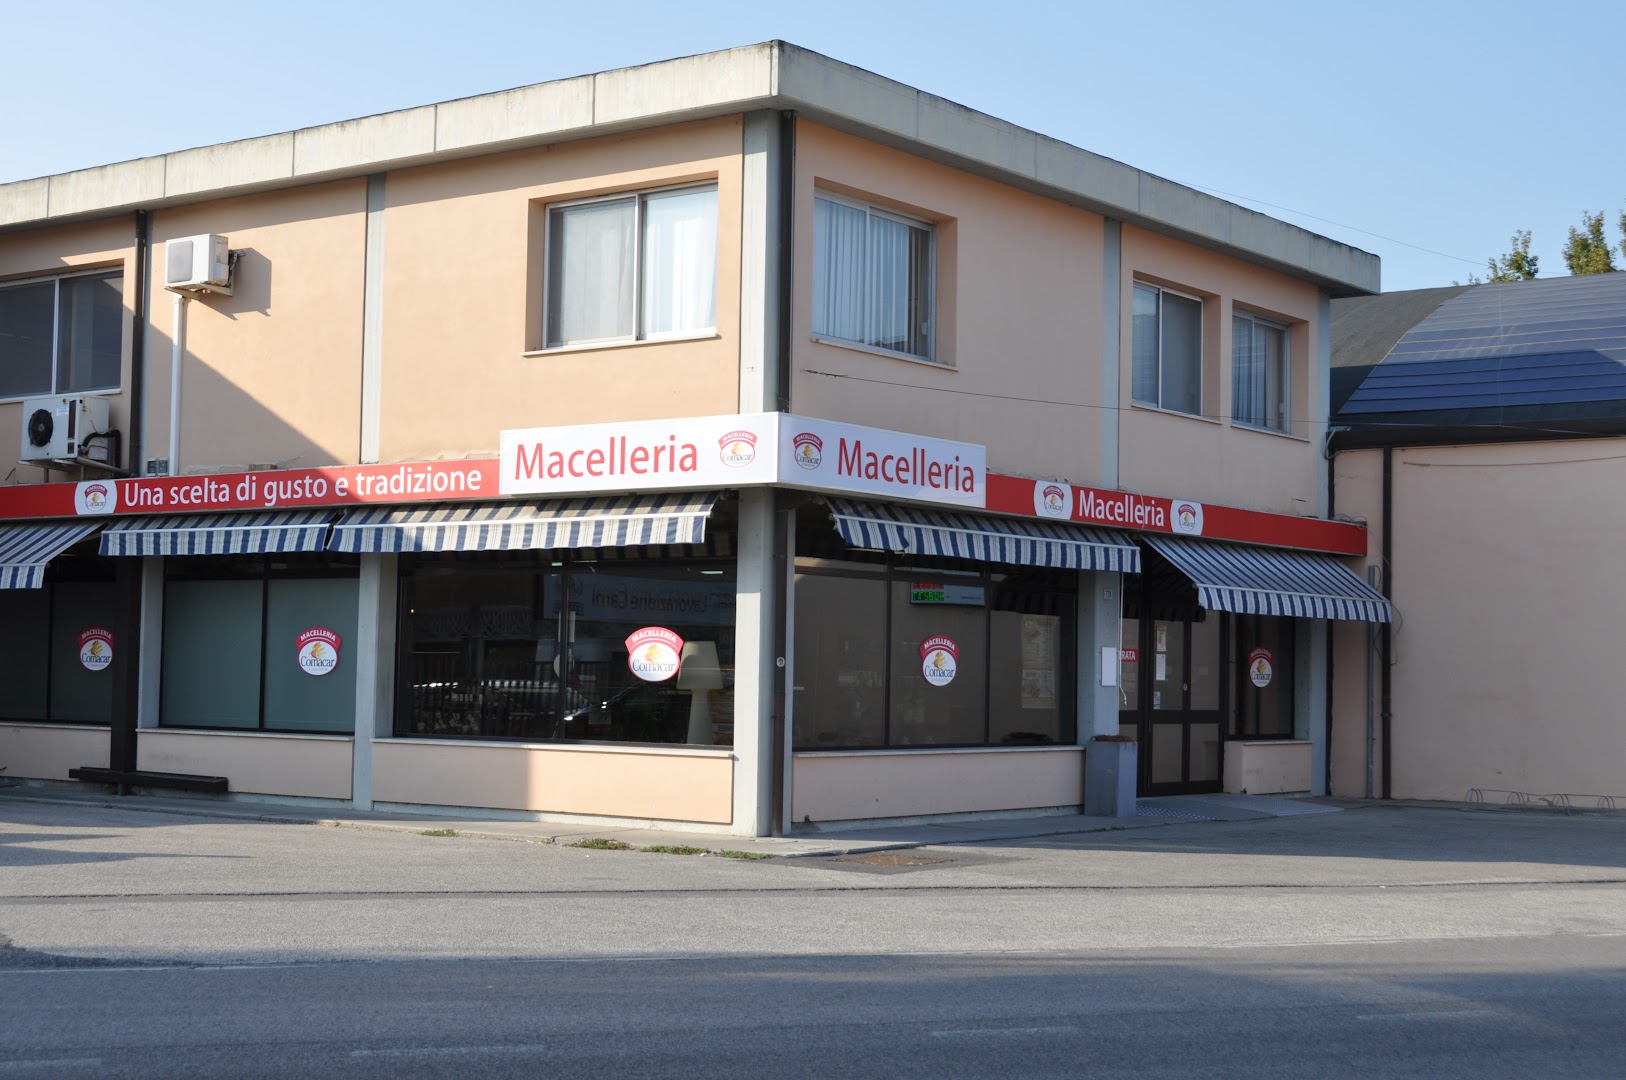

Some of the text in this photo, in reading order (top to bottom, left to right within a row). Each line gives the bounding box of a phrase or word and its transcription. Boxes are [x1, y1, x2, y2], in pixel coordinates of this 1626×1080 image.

[722, 432, 753, 443] MACELLERIA
[515, 434, 697, 480] Macelleria
[837, 437, 975, 493] Macelleria
[124, 465, 482, 507] Una scelta di gusto e tradizione
[1079, 489, 1165, 527] Macelleria
[300, 629, 336, 641] MACELLERIA
[631, 629, 677, 643] MACELLERIA
[924, 638, 955, 651] MACELLERIA
[300, 655, 335, 667] Comacar
[632, 658, 676, 672] Comacar
[925, 665, 955, 678] Comacar
